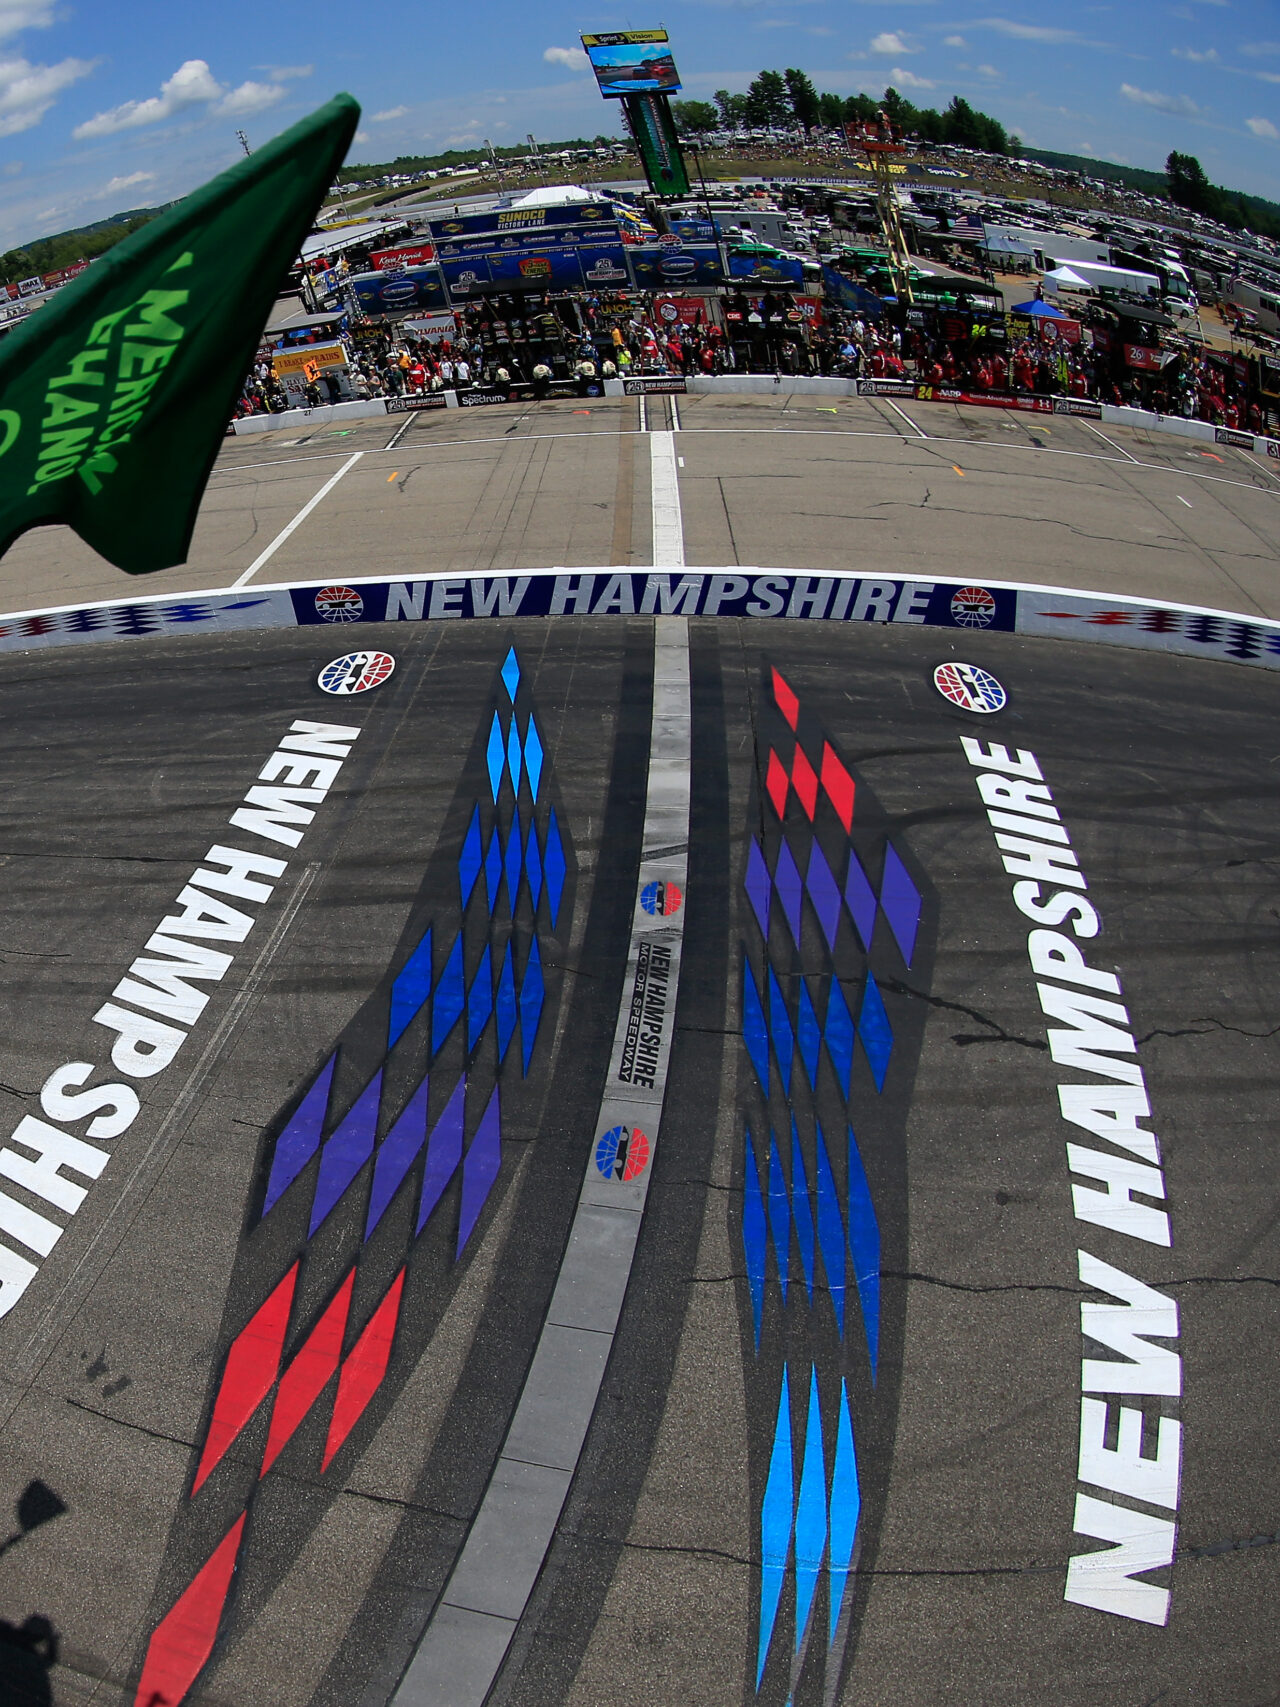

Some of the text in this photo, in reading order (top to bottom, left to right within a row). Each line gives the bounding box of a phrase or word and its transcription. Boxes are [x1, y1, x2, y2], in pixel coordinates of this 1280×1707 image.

[599, 32, 654, 43] Sprint Vision
[497, 208, 546, 224] SUNOCO
[497, 218, 545, 230] VICTORY LANE
[414, 325, 455, 336] YLVANIA
[462, 394, 503, 406] Spectrum
[917, 385, 933, 400] 24
[419, 396, 445, 405] HAMPSHIRE
[383, 573, 943, 625] NEW HAMPSHIRE
[228, 719, 362, 849] NEW
[620, 943, 650, 1083] MOTOR SPEEDWAY
[633, 944, 672, 1090] NEW HAMPSHIRE
[958, 735, 1182, 1628] NEW HAMPSHIRE
